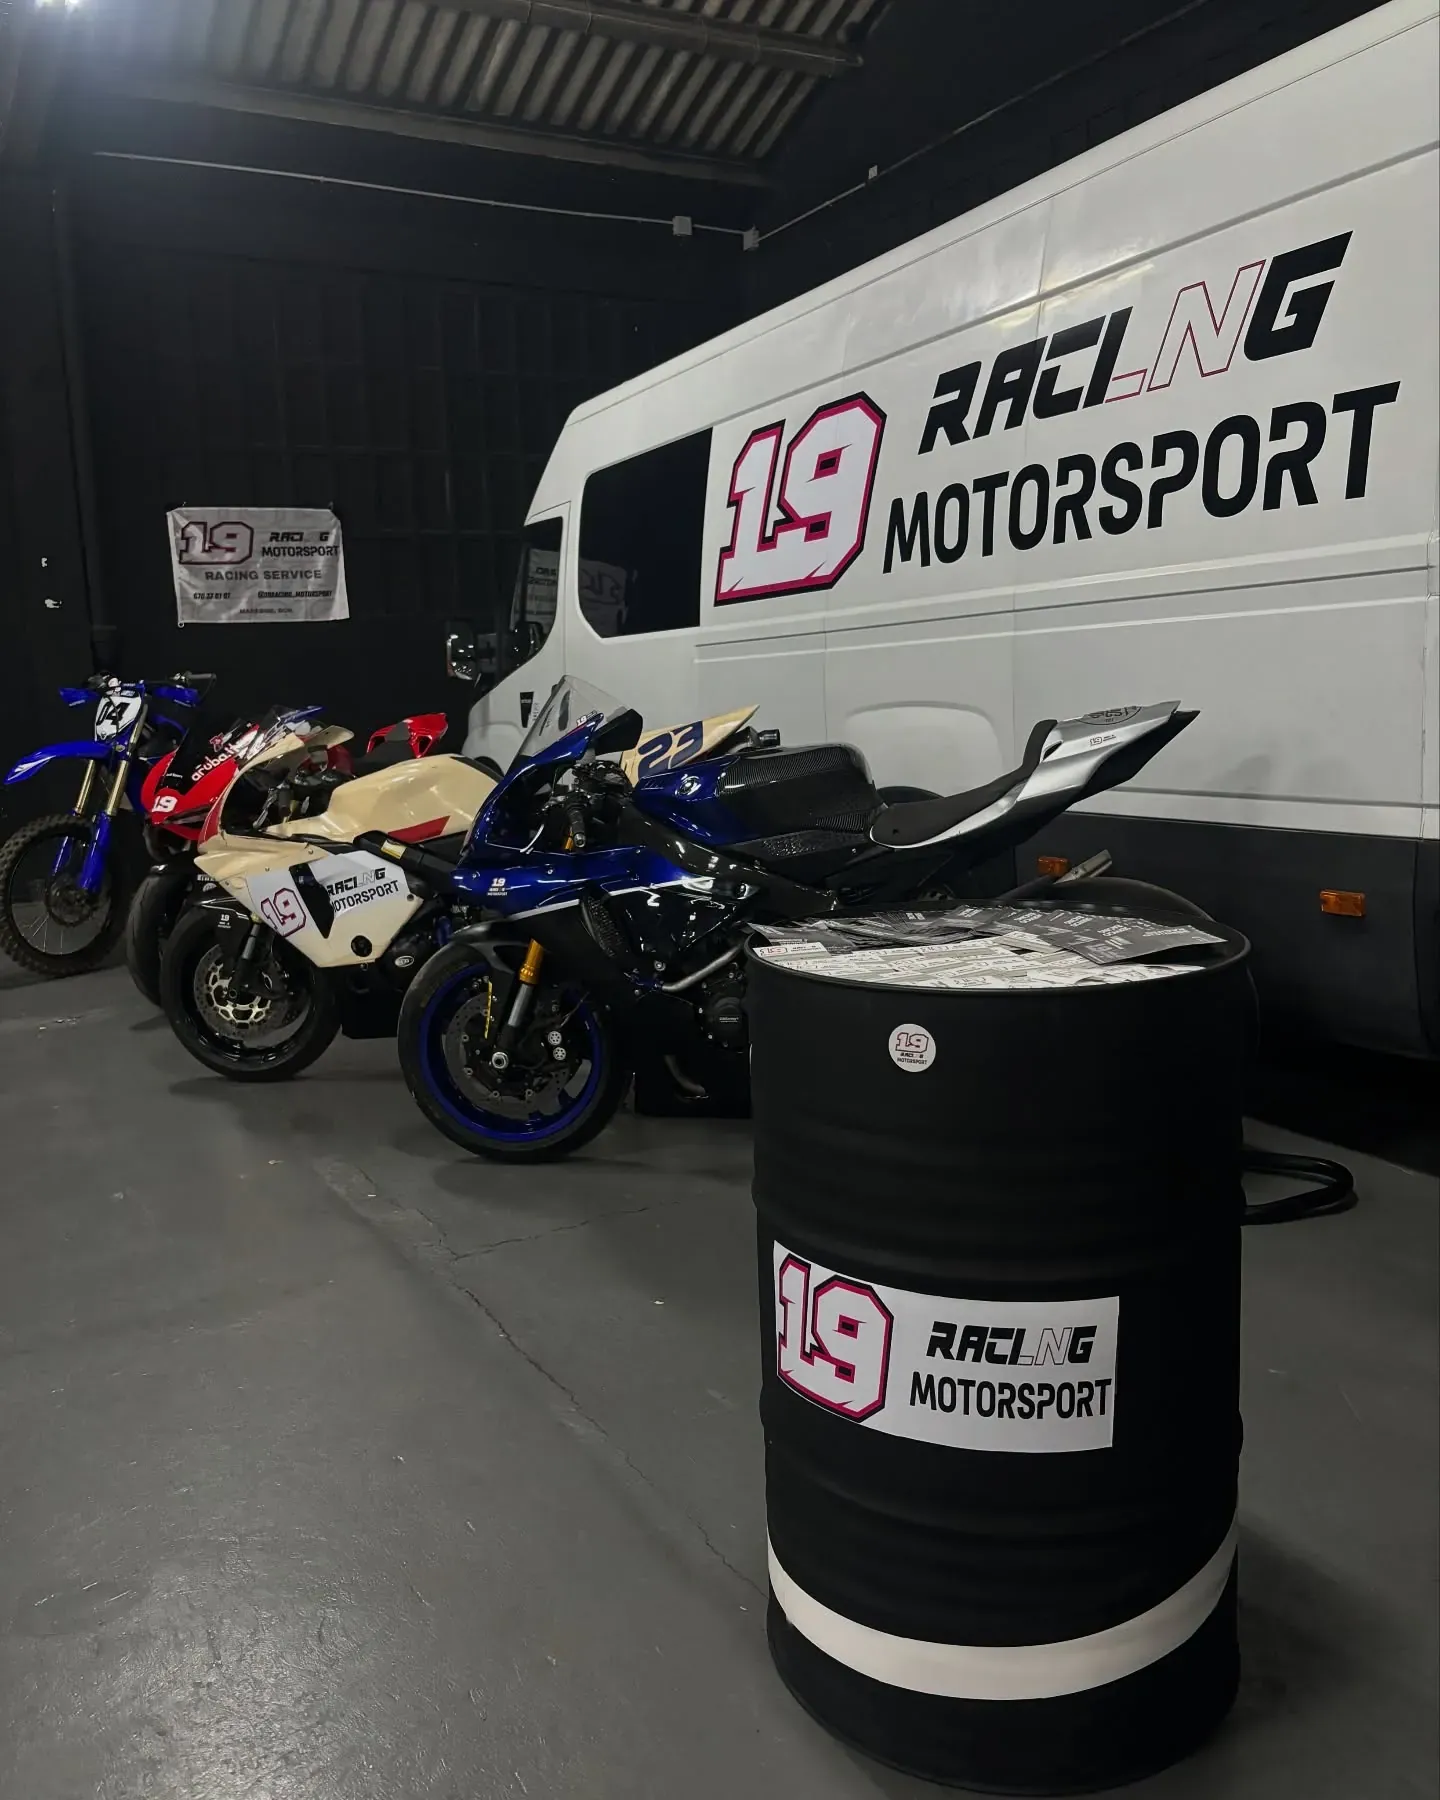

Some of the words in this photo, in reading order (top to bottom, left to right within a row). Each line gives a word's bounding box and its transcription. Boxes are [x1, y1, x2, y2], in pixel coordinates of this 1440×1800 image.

[713, 391, 887, 606] 19
[882, 381, 1401, 574] MOTORSPORT
[179, 521, 254, 565] 19
[261, 545, 340, 558] MOTORSPORT
[205, 570, 259, 581] RACING
[263, 569, 322, 580] SERVICE
[638, 720, 704, 779] 23
[151, 795, 179, 813] 19
[491, 877, 506, 887] 19
[261, 887, 307, 938] 19
[895, 1032, 929, 1053] 19
[778, 1253, 895, 1423] 19
[909, 1371, 1113, 1420] MOTORSPORT
